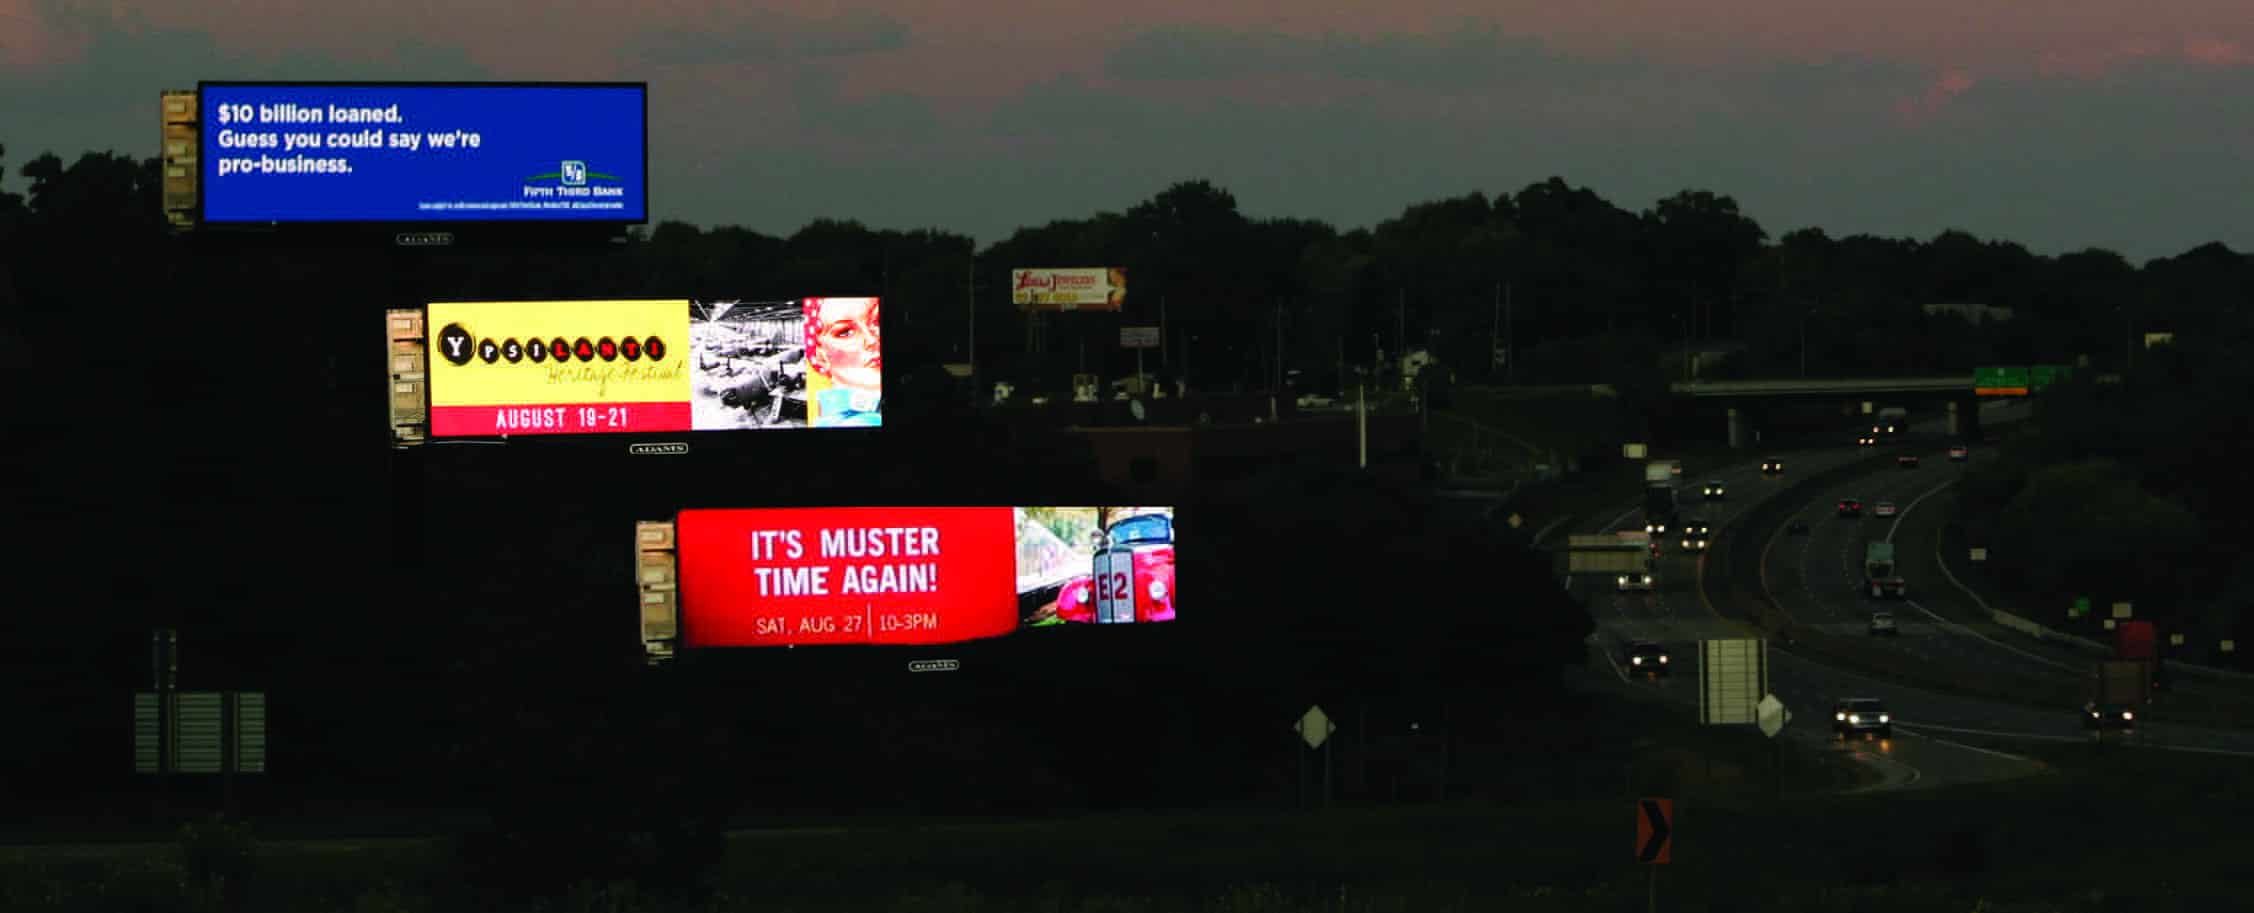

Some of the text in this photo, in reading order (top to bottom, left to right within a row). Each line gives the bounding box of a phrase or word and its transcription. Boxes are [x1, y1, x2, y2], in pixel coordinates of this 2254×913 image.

[219, 102, 403, 125] $10 billion loaned.
[218, 129, 481, 151] Guess you could say we're
[219, 154, 353, 176] pro-business.
[444, 332, 661, 360] YPSILANTI
[496, 407, 628, 429] AUGUST 19-21
[752, 527, 940, 561] IT'S MUSTER
[754, 562, 937, 597] TIME AGAIN!
[1098, 571, 1128, 600] E2
[756, 612, 938, 635] SAT, AUG 27 10-3PM
